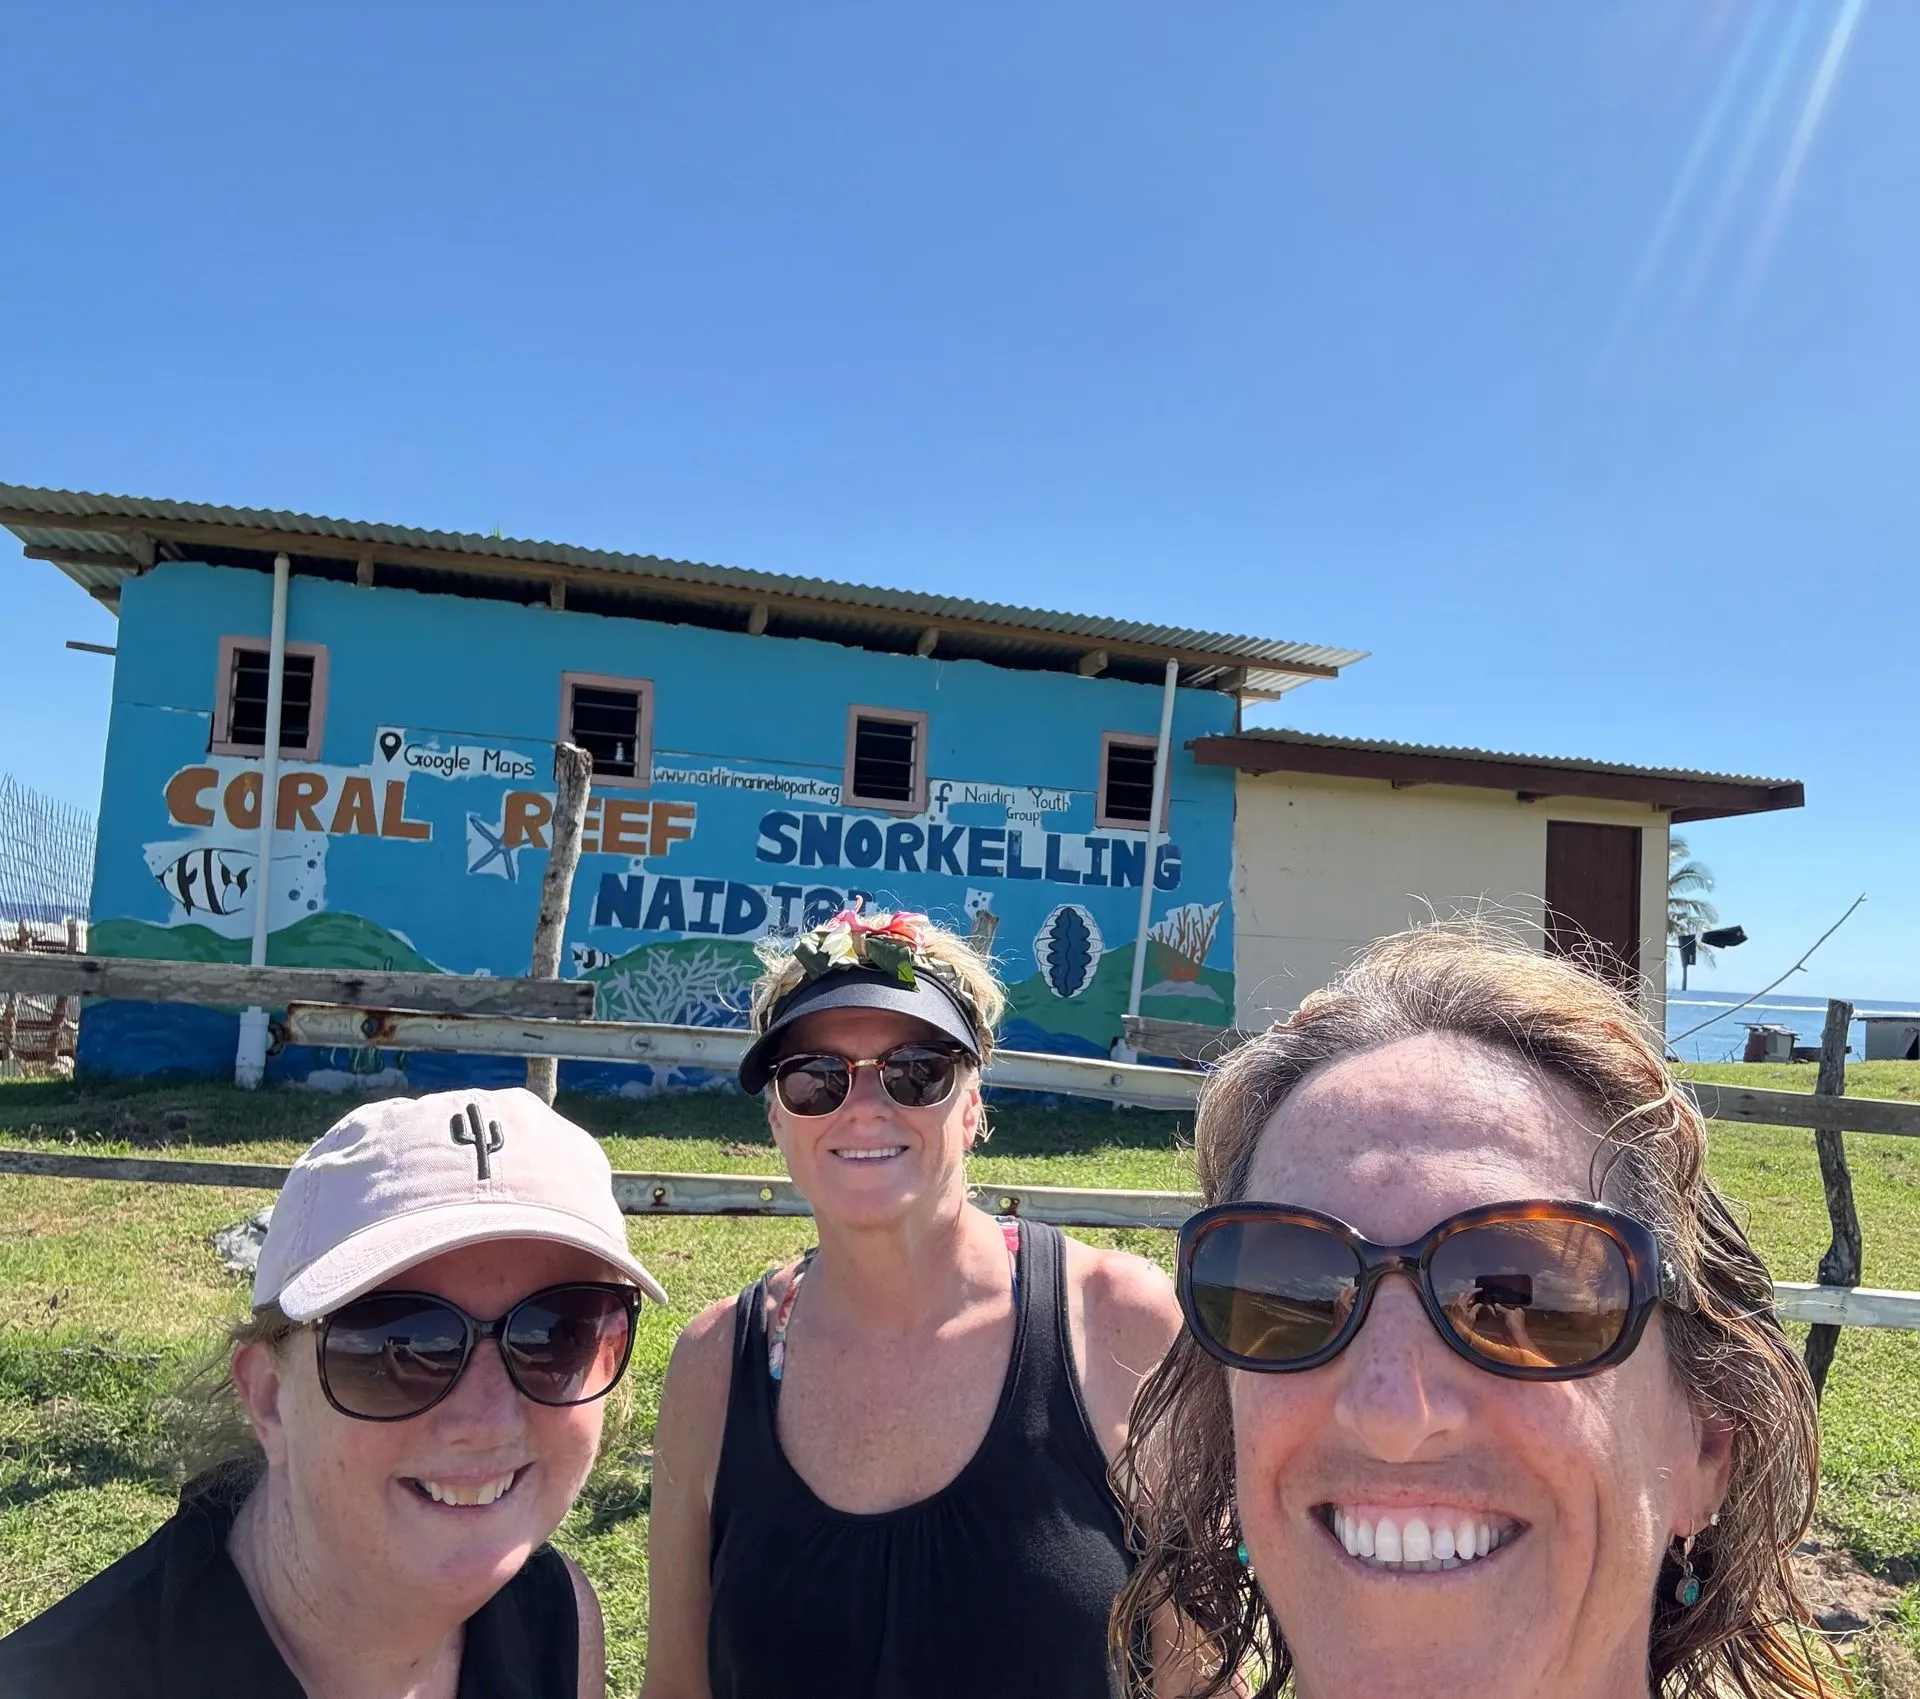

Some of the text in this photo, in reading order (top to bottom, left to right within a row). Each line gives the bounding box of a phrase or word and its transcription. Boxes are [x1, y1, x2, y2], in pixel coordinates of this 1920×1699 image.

[404, 743, 536, 779] Google Maps
[166, 768, 431, 839] CORAL
[964, 785, 1071, 812] Naidiri Youth
[1006, 806, 1041, 827] Group
[756, 811, 1182, 892] SNORKELLING
